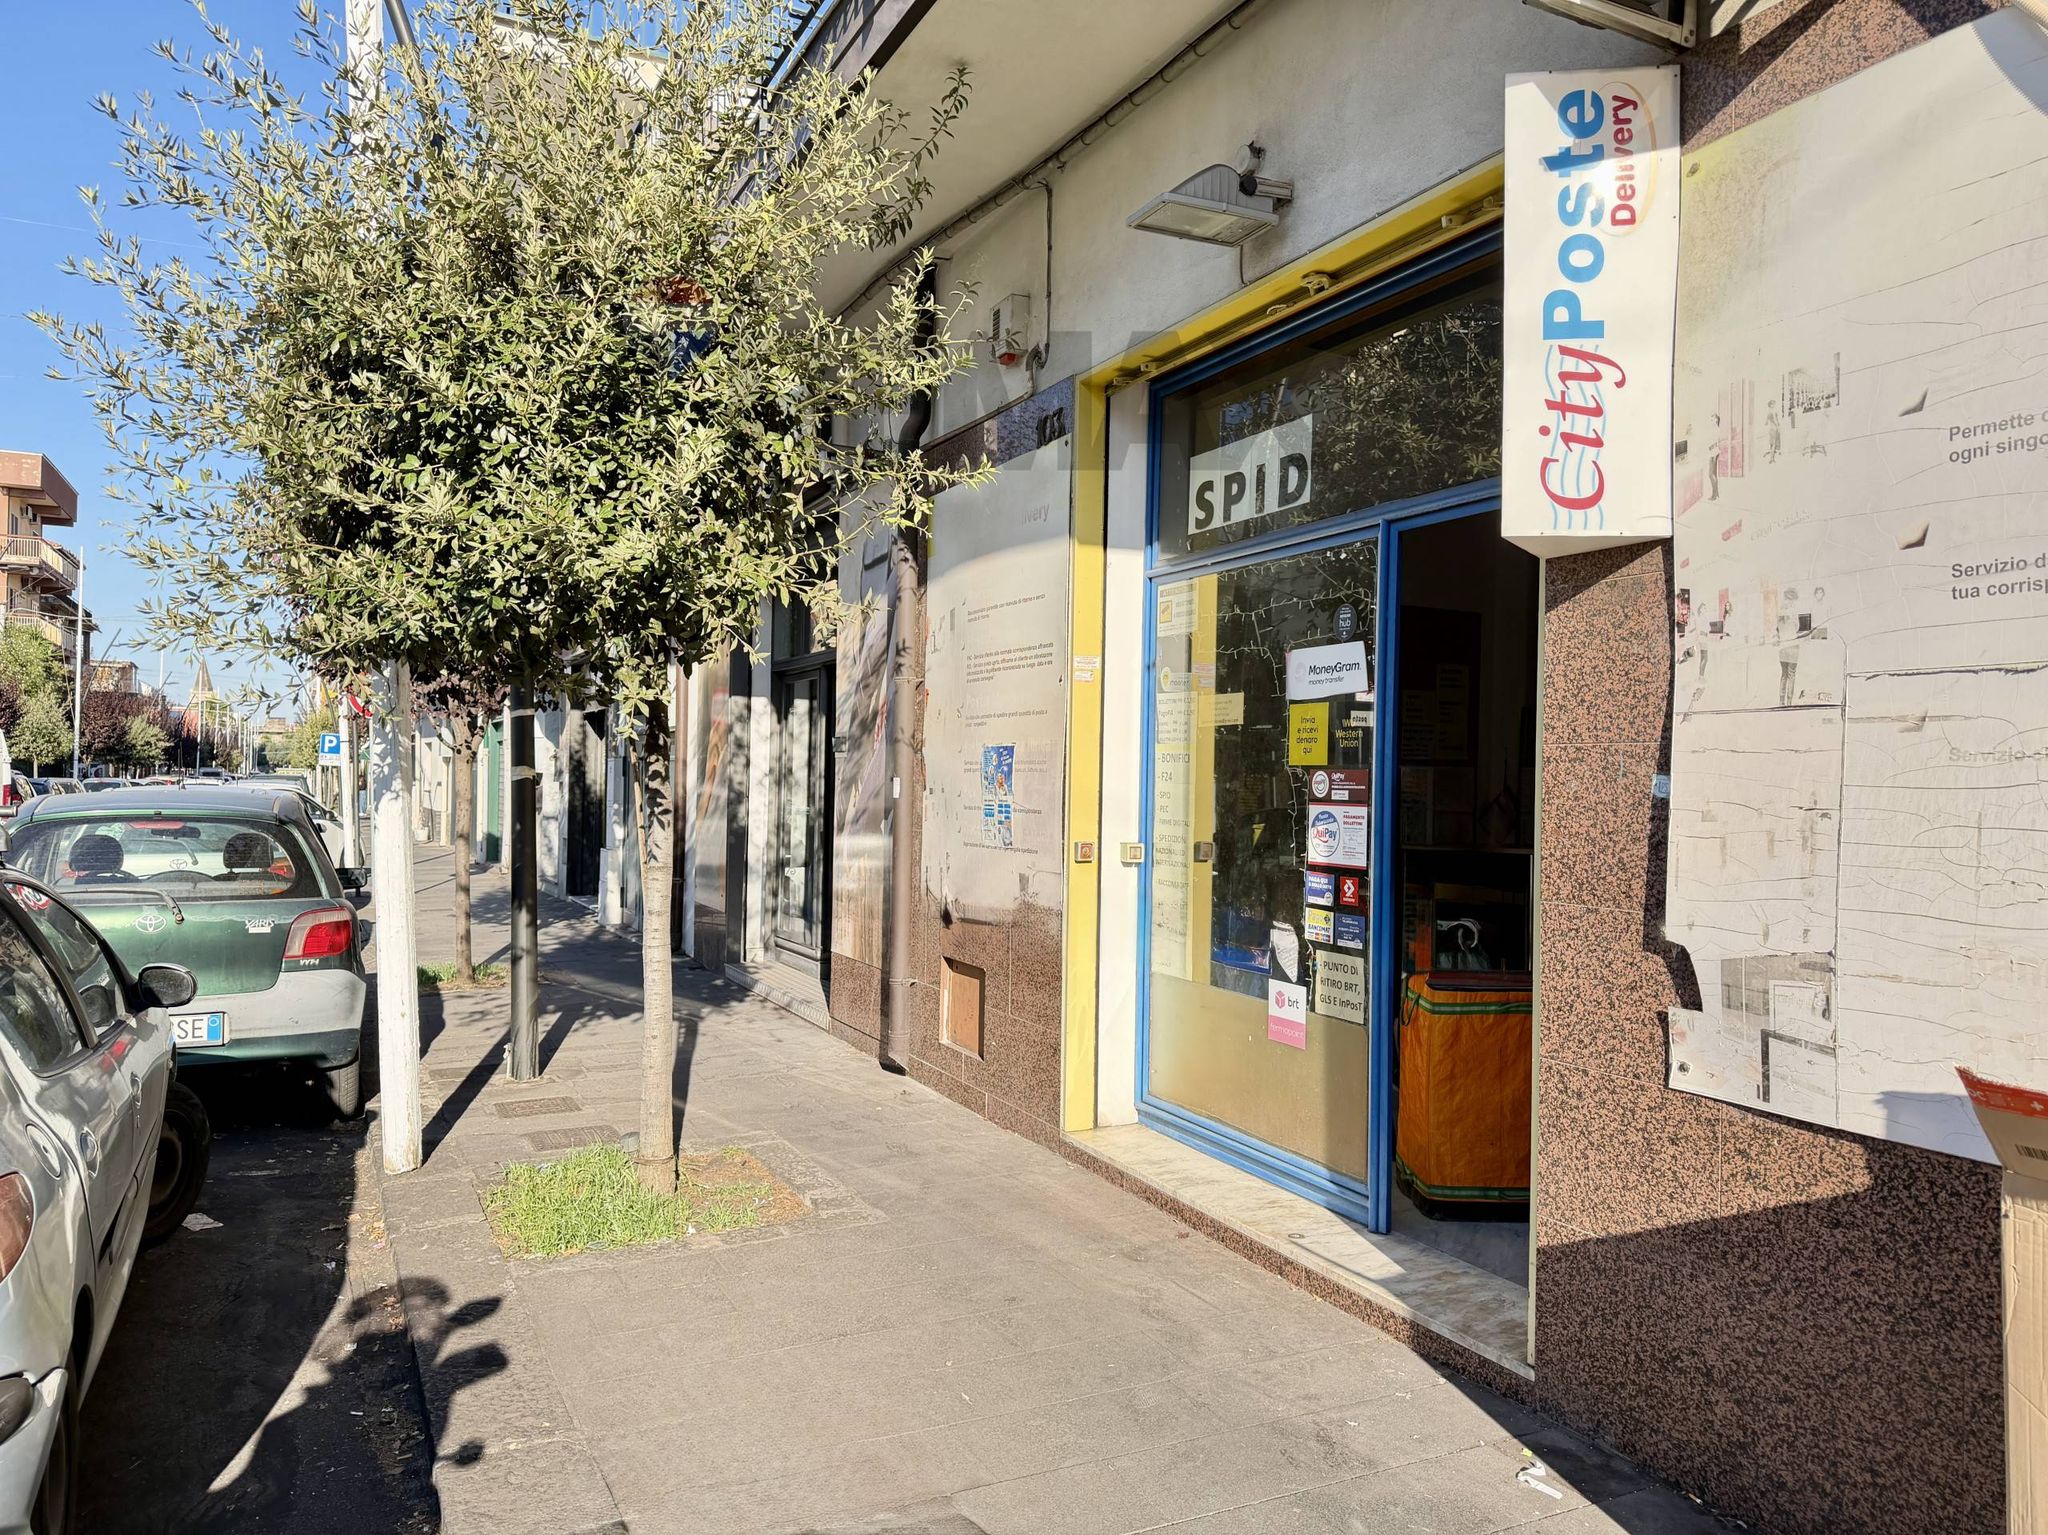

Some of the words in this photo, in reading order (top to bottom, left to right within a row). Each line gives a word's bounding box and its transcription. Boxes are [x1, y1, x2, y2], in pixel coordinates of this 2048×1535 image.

[1610, 94, 1638, 227] Delivery
[1949, 413, 2035, 442] Permette
[1949, 440, 1990, 464] ogni
[1194, 451, 1309, 531] SPID
[1951, 556, 2028, 579] Servizio
[1951, 586, 1981, 600] tua
[1339, 618, 1352, 628] hub
[1308, 661, 1361, 676] MoneyGram
[1308, 677, 1325, 686] money
[1324, 675, 1345, 684] transfer
[1301, 715, 1316, 724] Invia
[1296, 735, 1318, 744] denaro
[1335, 729, 1363, 738] Western
[323, 735, 338, 753] P
[1340, 738, 1359, 748] Union
[1302, 746, 1313, 755] qui
[1161, 771, 1173, 782] F24
[1159, 805, 1169, 814] PEC
[1312, 827, 1338, 842] QuiPay
[245, 918, 275, 930] YARIS
[1323, 960, 1349, 974] PUNTO
[1350, 966, 1359, 976] DI
[1320, 976, 1343, 990] RITIRO
[1344, 980, 1361, 996] BRT,
[1287, 996, 1300, 1009] brt
[1320, 993, 1332, 1004] GLS
[1333, 996, 1338, 1006] E
[172, 1018, 204, 1041] SE
